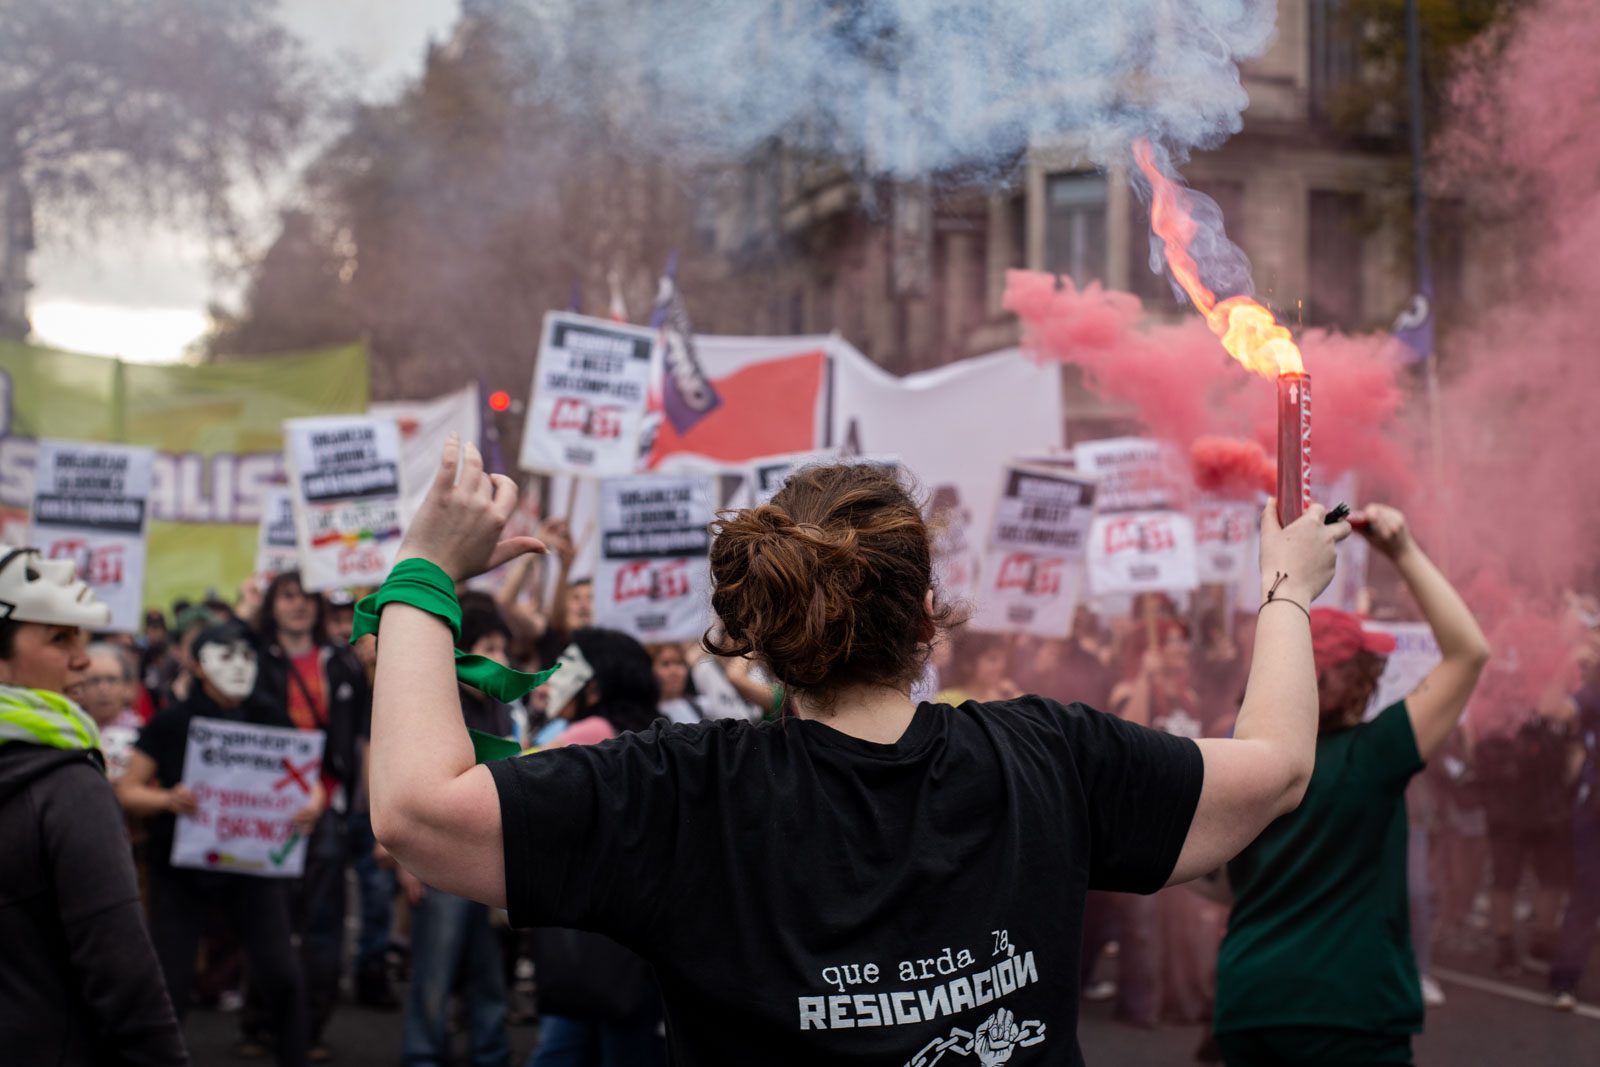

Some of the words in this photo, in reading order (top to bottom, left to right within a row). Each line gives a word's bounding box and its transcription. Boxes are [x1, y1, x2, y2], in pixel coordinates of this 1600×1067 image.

[798, 943, 1039, 1031] RESIGNACIÓN
[822, 962, 880, 993] que
[898, 947, 976, 983] arda
[991, 929, 1009, 957] la
